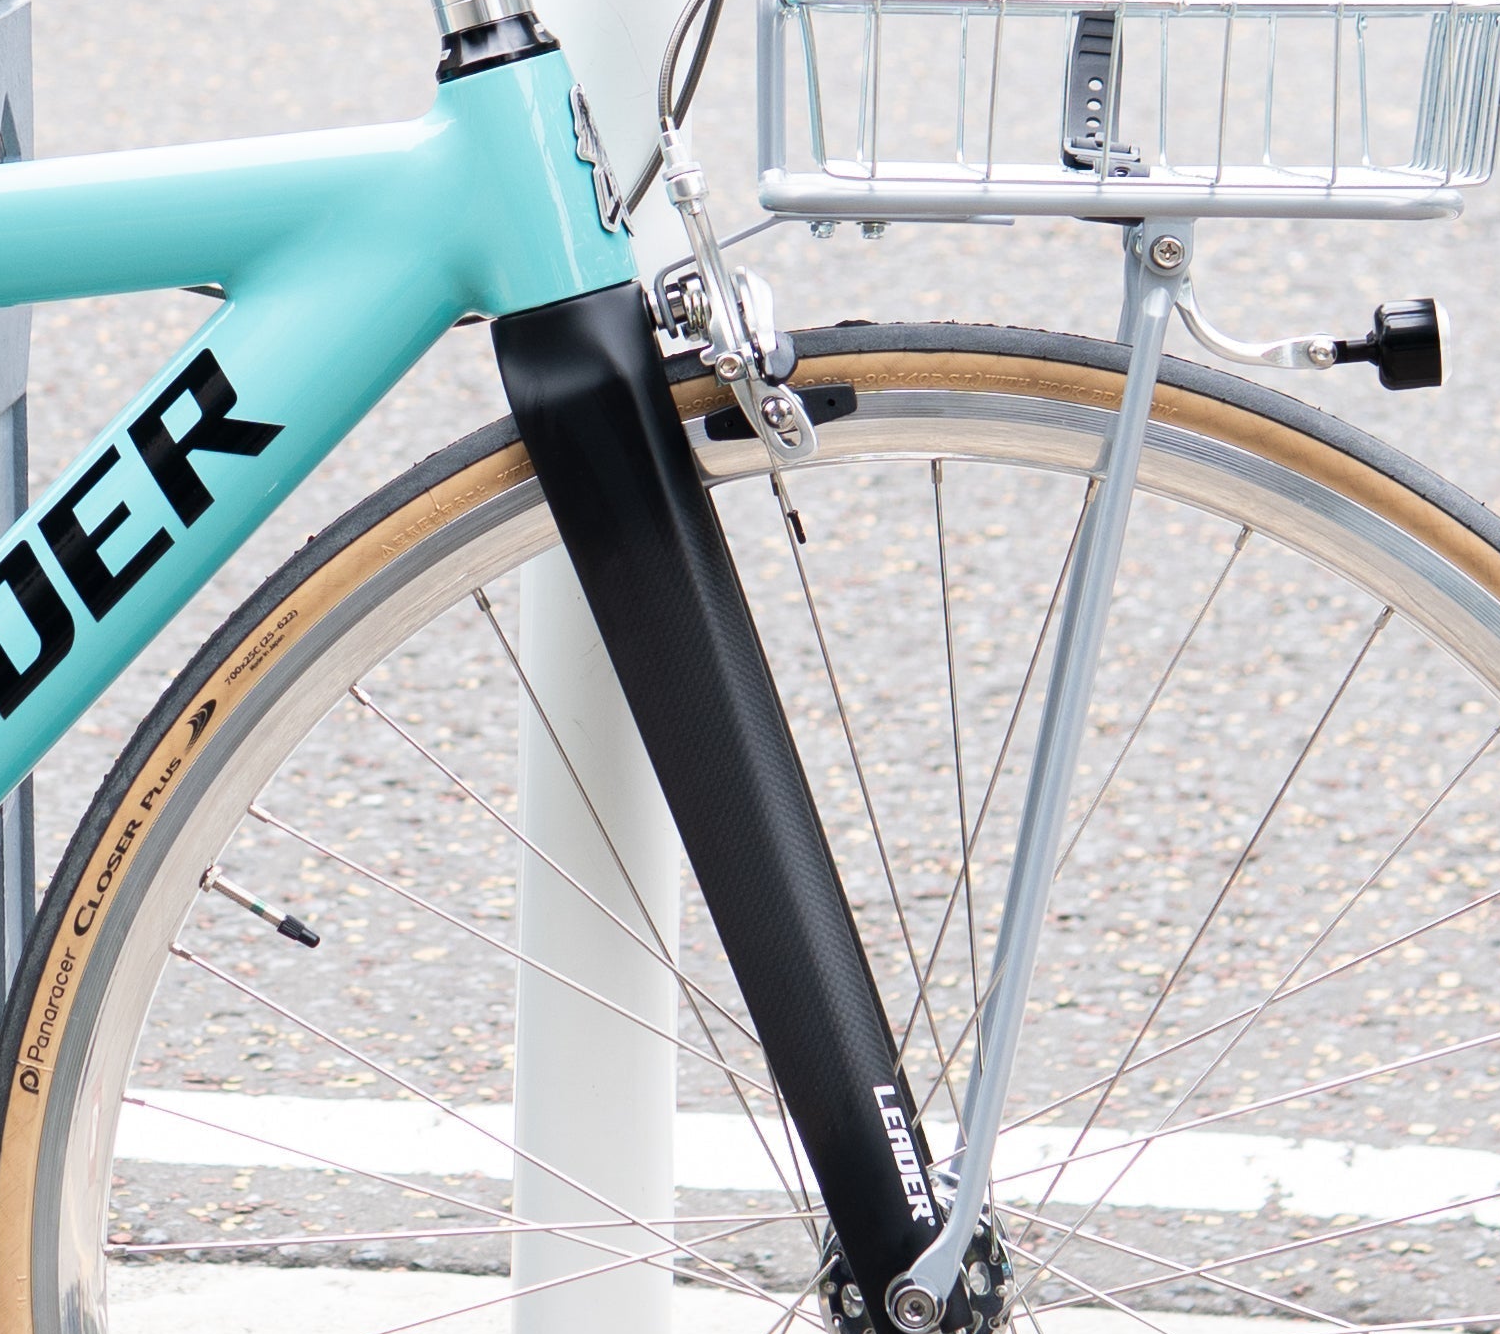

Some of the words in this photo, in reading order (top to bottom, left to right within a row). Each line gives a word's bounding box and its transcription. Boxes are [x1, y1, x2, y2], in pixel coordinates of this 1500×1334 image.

[224, 645, 261, 685] 700x25C
[259, 610, 298, 648] (25-622)
[27, 947, 76, 1061] Panaracer
[73, 820, 143, 938] CLOSER
[141, 757, 182, 811] PLUS
